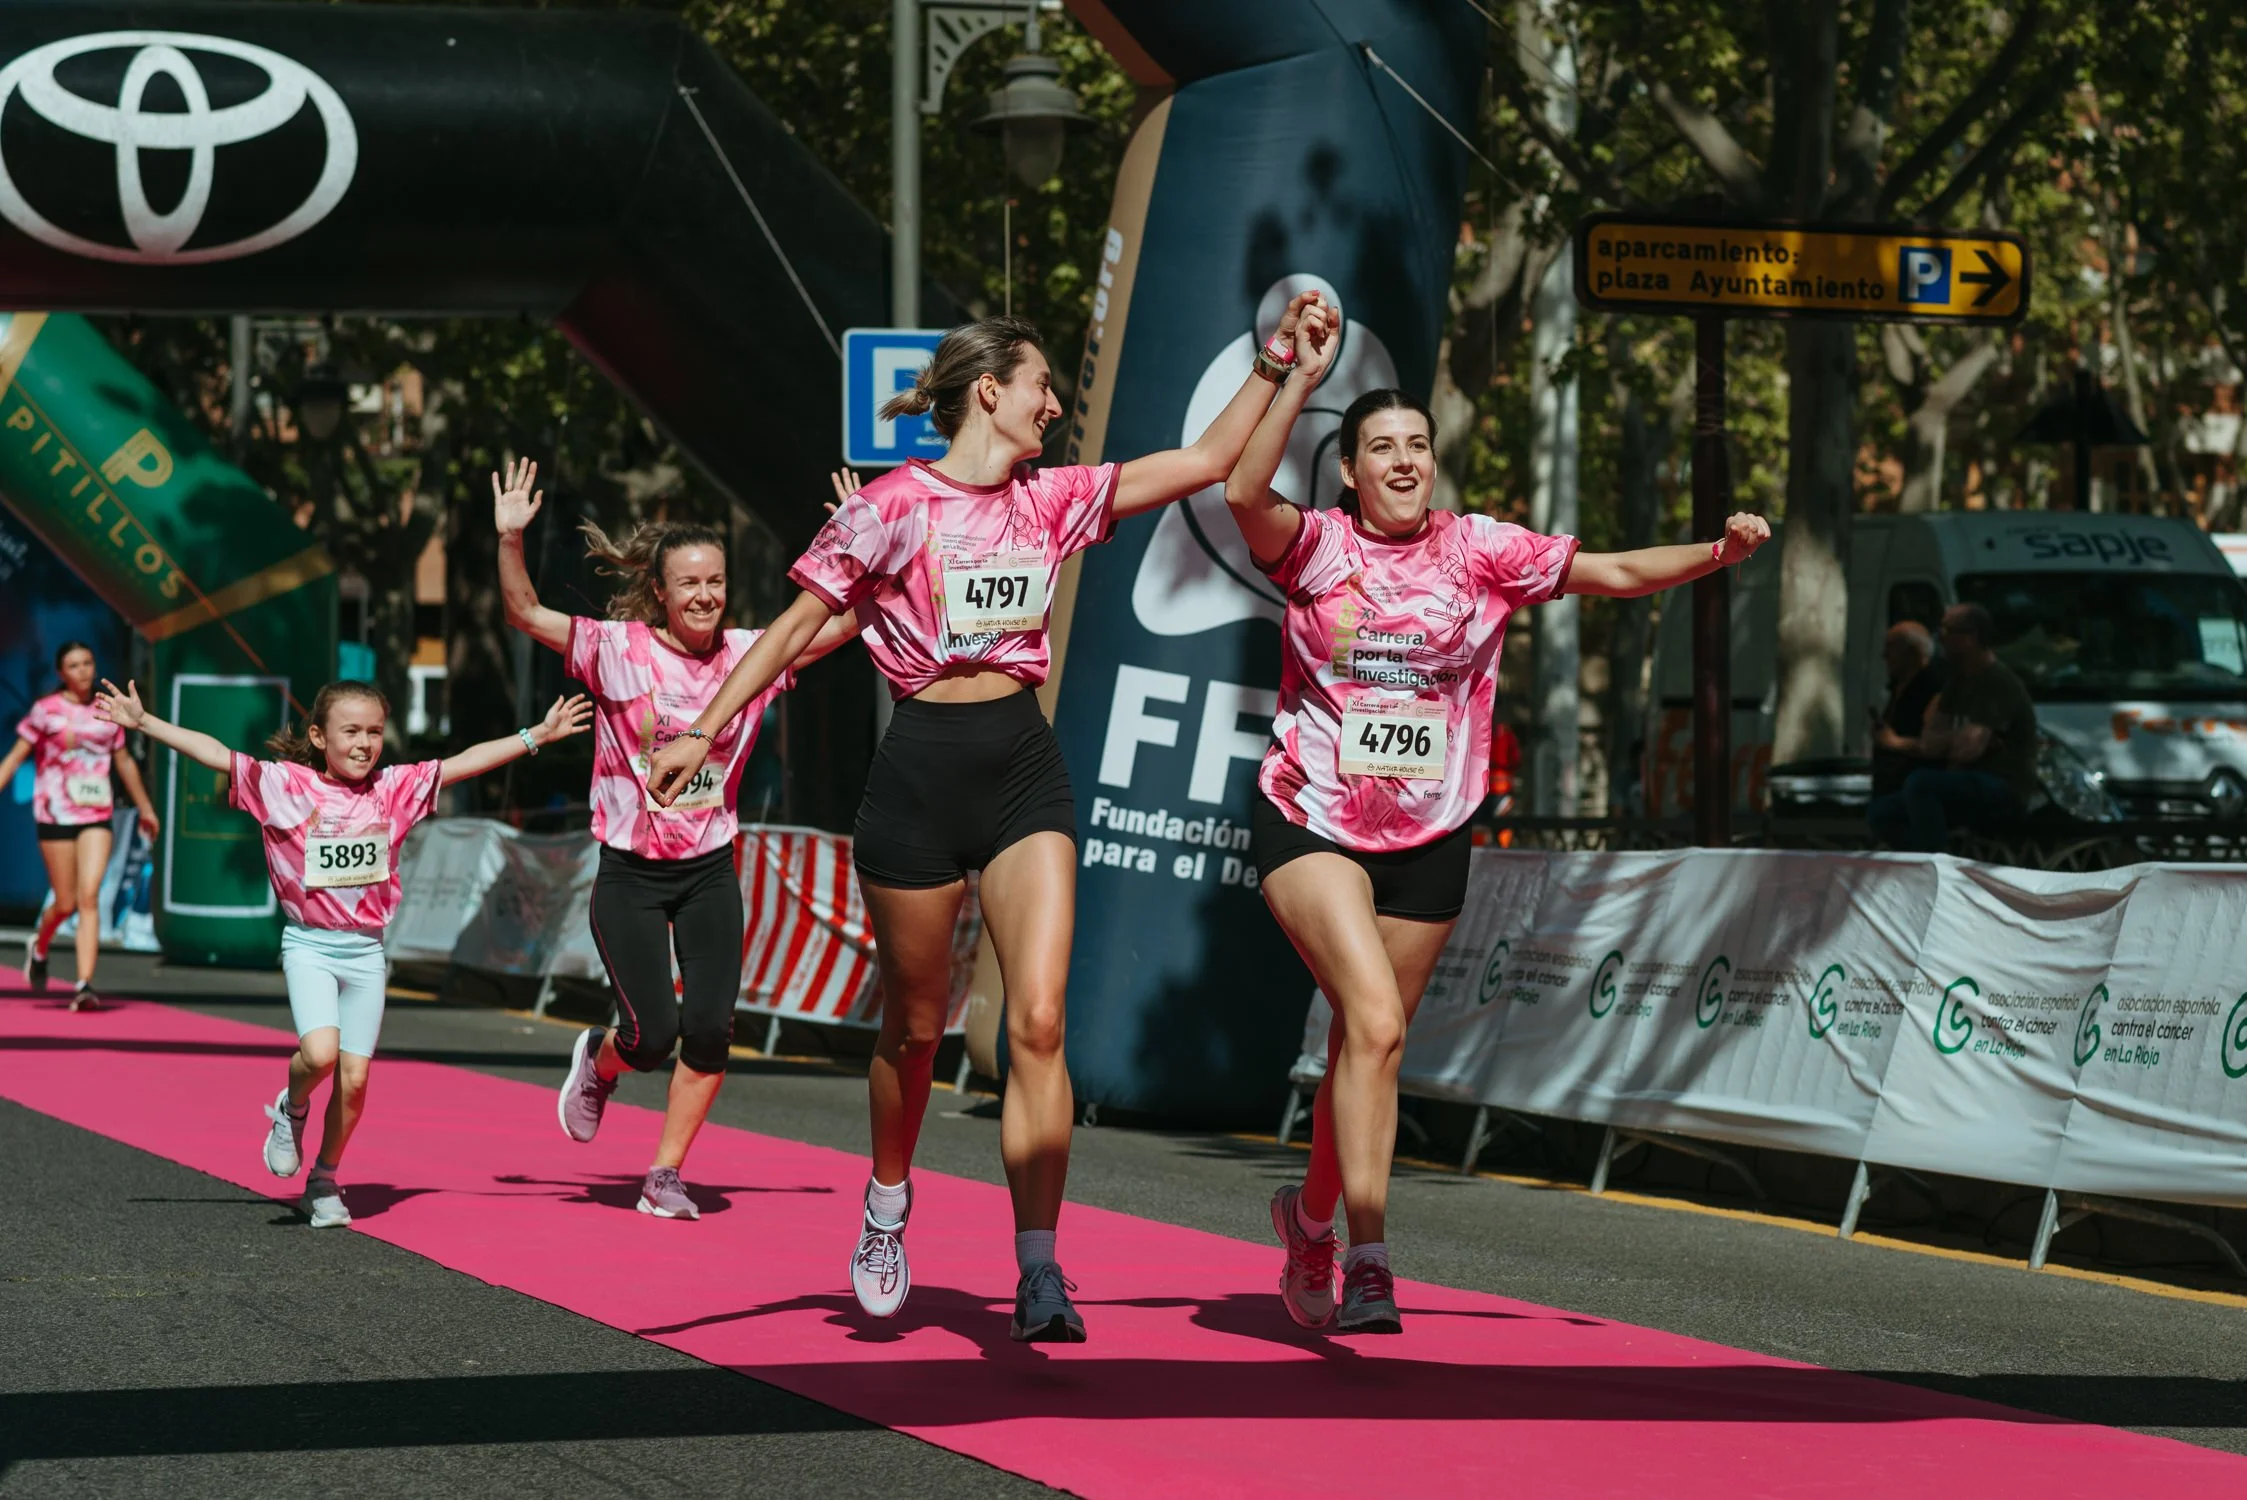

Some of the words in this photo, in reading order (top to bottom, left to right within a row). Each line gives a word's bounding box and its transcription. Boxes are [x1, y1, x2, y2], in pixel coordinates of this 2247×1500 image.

[1597, 237, 1799, 267] aparcamiento:
[1597, 268, 1670, 293] plaza
[1689, 270, 1885, 300] Ayuntamiento
[1907, 251, 1942, 298] P
[1066, 227, 1123, 466] errer.org
[6, 405, 185, 599] PITILLOS
[2023, 528, 2176, 566] sapje
[965, 575, 1029, 609] 4797
[1360, 607, 1376, 620] XI
[1355, 625, 1424, 645] Carrera
[1353, 649, 1384, 664] por
[1386, 649, 1403, 663] la
[1352, 666, 1458, 687] Investigación
[657, 714, 671, 726] XI
[1359, 722, 1431, 757] 4796
[680, 770, 714, 795] 94
[1090, 796, 1252, 851] Fundación
[319, 842, 377, 869] 5893
[1082, 837, 1157, 873] para
[1173, 851, 1207, 881] el
[1220, 854, 1262, 891] De
[1845, 998, 1871, 1014] contra
[1872, 998, 1881, 1014] el
[1987, 990, 2039, 1008] asociación
[2040, 993, 2080, 1014] española
[2117, 993, 2172, 1015] asociación
[2172, 996, 2220, 1019] española
[1837, 1022, 1849, 1035] en
[1849, 1021, 1861, 1036] La
[1861, 1021, 1882, 1039] Rioja
[1981, 1013, 2013, 1031] contra
[2014, 1016, 2026, 1032] el
[2026, 1016, 2058, 1035] cáncer
[2111, 1018, 2144, 1036] contra
[2145, 1020, 2156, 1038] el
[2157, 1021, 2194, 1040] cáncer
[1973, 1038, 1989, 1053] en
[1989, 1036, 2003, 1055] La
[2003, 1037, 2026, 1060] Rioja
[2103, 1046, 2118, 1063] en
[2118, 1043, 2132, 1064] La
[2134, 1045, 2160, 1070] Rioja
